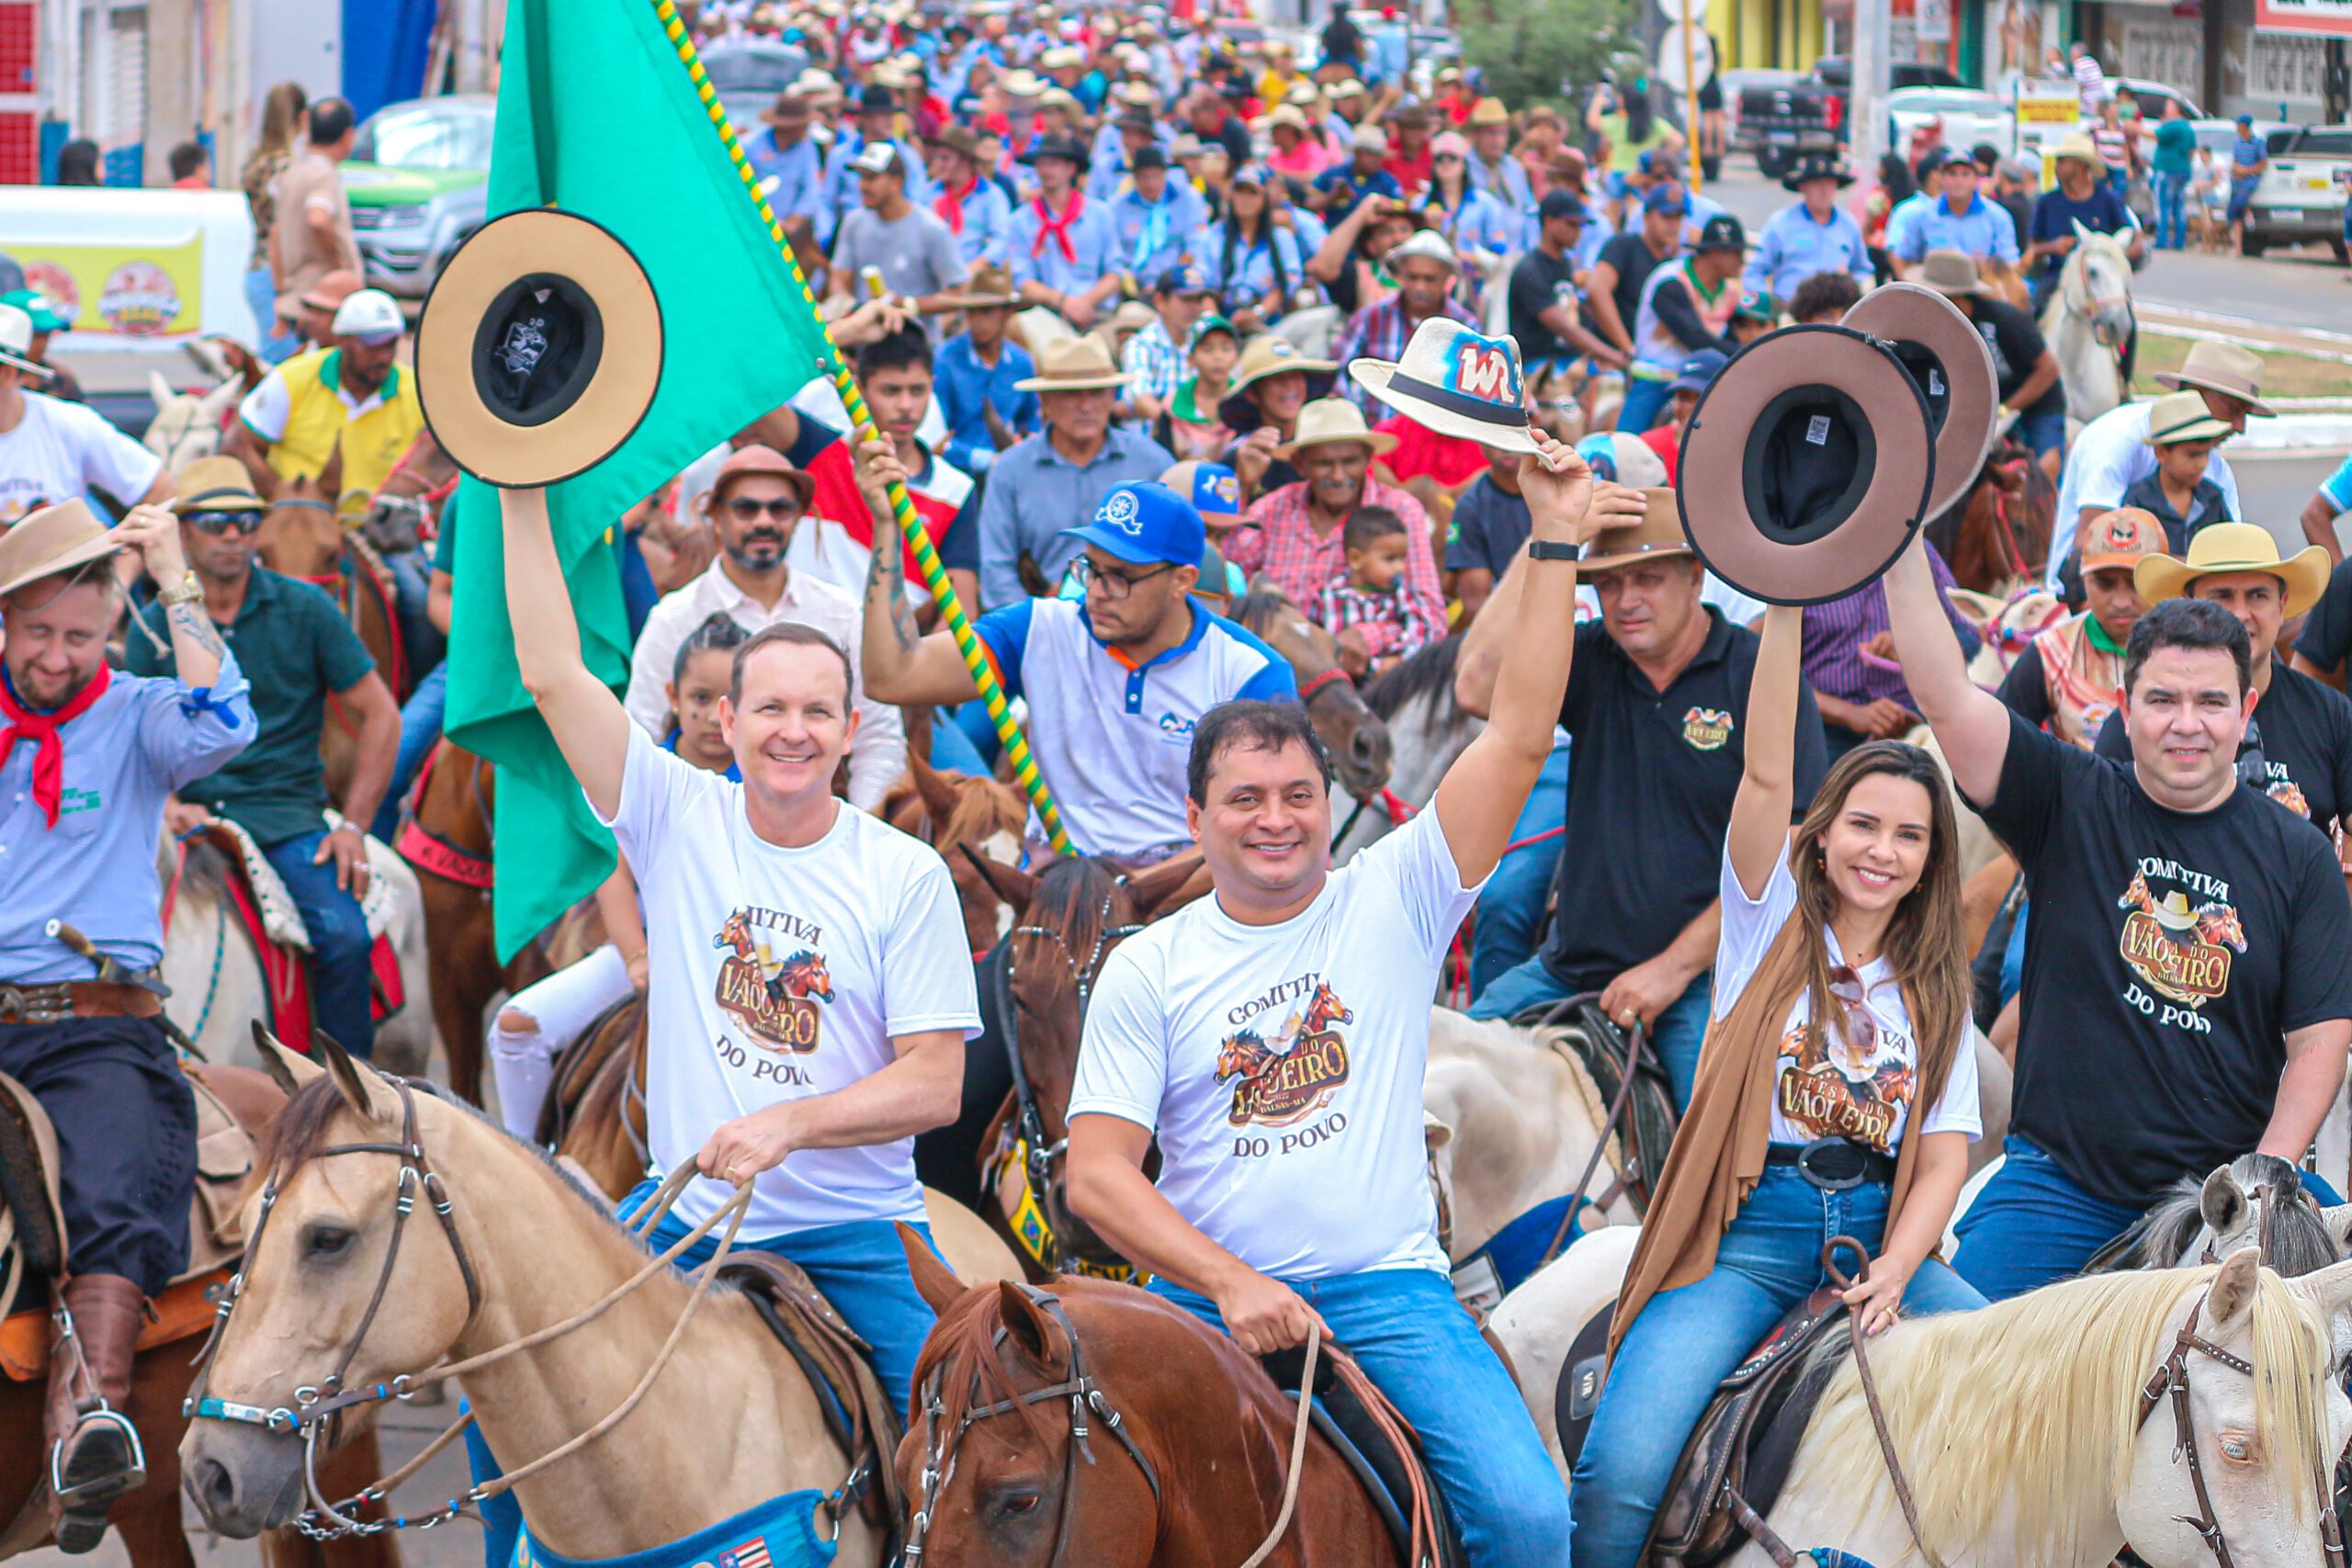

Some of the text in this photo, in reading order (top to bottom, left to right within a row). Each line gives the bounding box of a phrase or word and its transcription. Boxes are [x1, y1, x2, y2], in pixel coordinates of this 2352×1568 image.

[2138, 856, 2229, 902] OMITIVA
[2123, 982, 2155, 1015] DO
[1300, 1039, 1319, 1055] DO
[1865, 1101, 1884, 1117] DO
[1233, 1112, 1348, 1157] DO POVO
